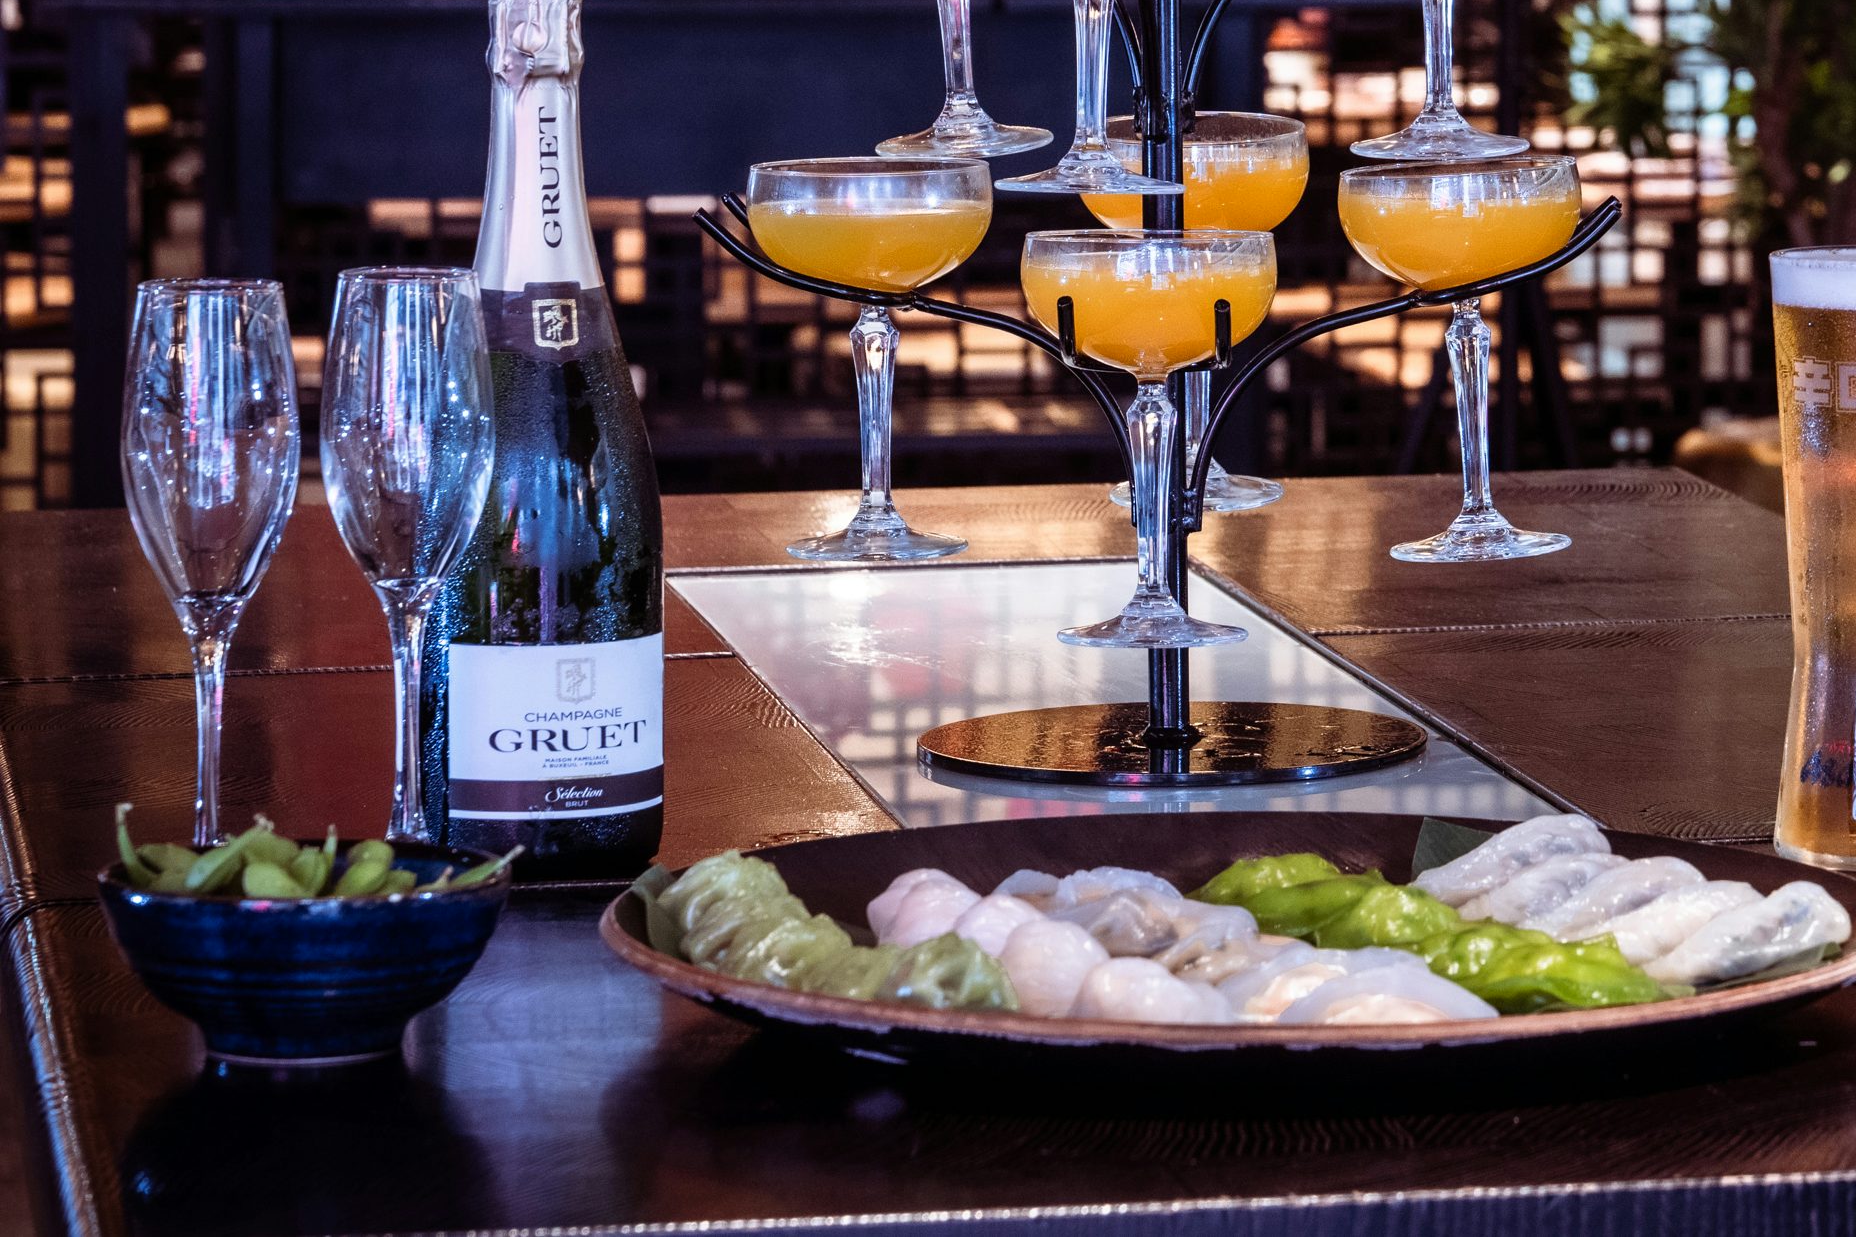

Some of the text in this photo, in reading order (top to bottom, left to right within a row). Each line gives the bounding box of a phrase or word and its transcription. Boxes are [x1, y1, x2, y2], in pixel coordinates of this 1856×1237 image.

[537, 105, 563, 249] GRUET
[524, 706, 623, 723] CHAMPAGNE
[488, 719, 647, 753] GRUET
[574, 754, 607, 762] FAMILIALE
[544, 785, 604, 803] Sélection
[565, 799, 590, 809] BRUT
